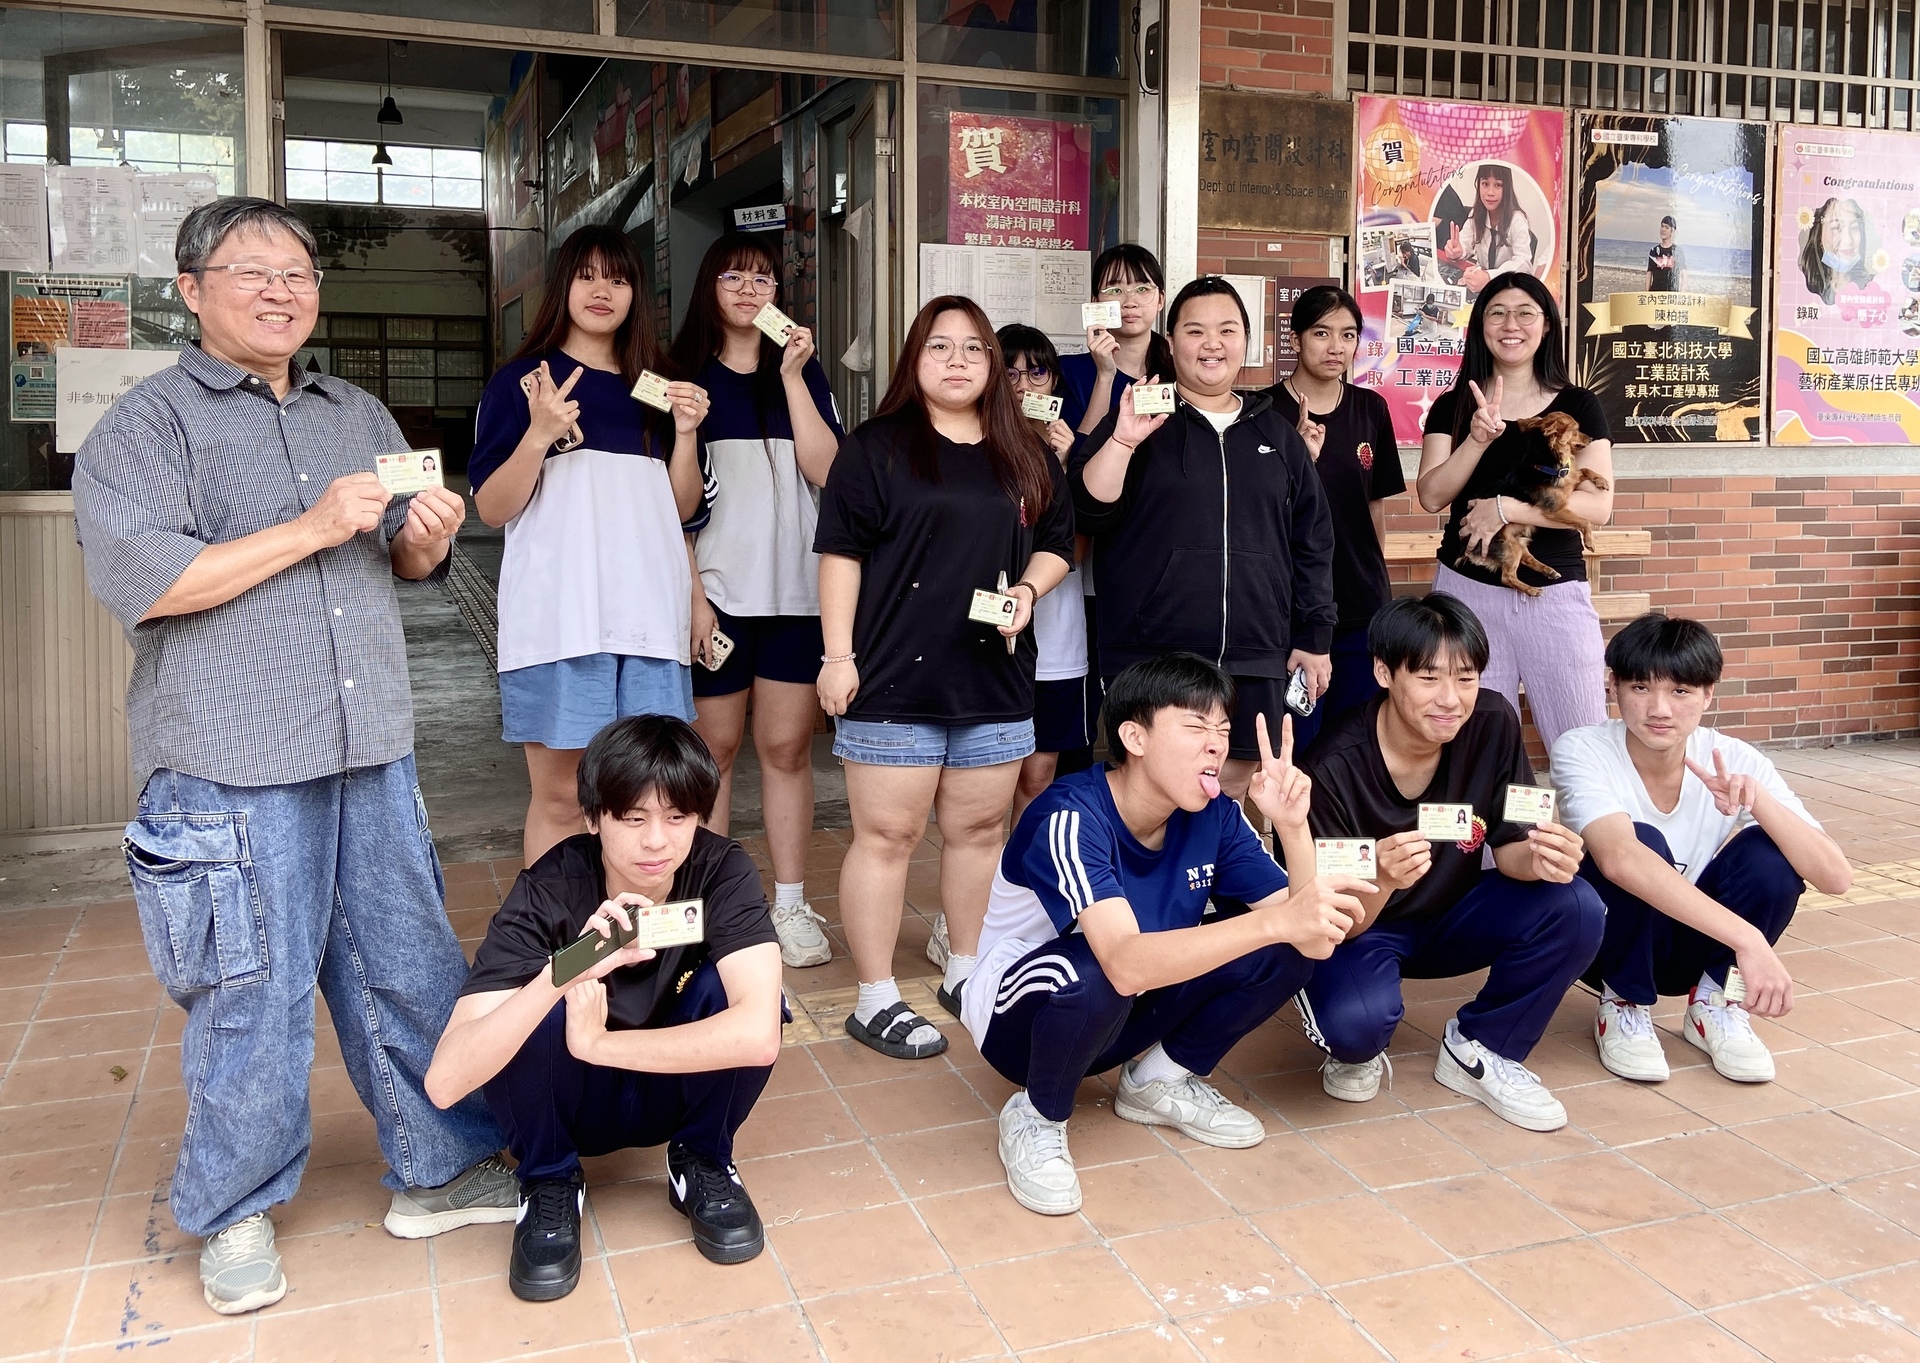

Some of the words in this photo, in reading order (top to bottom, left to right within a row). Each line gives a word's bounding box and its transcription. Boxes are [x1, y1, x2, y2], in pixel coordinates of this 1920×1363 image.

[958, 126, 1007, 179] 賀
[1201, 128, 1346, 171] 室內空間設計科
[1381, 140, 1405, 165] 賀
[1227, 181, 1236, 192] of
[1239, 181, 1272, 195] Interior
[1285, 184, 1314, 199] Space
[1317, 186, 1349, 200] Design
[1371, 164, 1467, 208] Congratulations
[1672, 163, 1763, 206] Congratulations
[1823, 175, 1915, 192] Congratulations
[959, 192, 1082, 216] 本校室內空間設計科
[741, 208, 779, 222] 材料室
[1279, 287, 1308, 302] 室內
[1796, 305, 1819, 320] 錄取
[1612, 341, 1733, 360] 國立臺北科技大學
[1806, 346, 1919, 367] 國立高雄師範大學
[1635, 363, 1710, 382] 工業設計系
[1798, 371, 1920, 391] 藝術產業原住民專班
[1624, 384, 1720, 399] 家具木工產學專班
